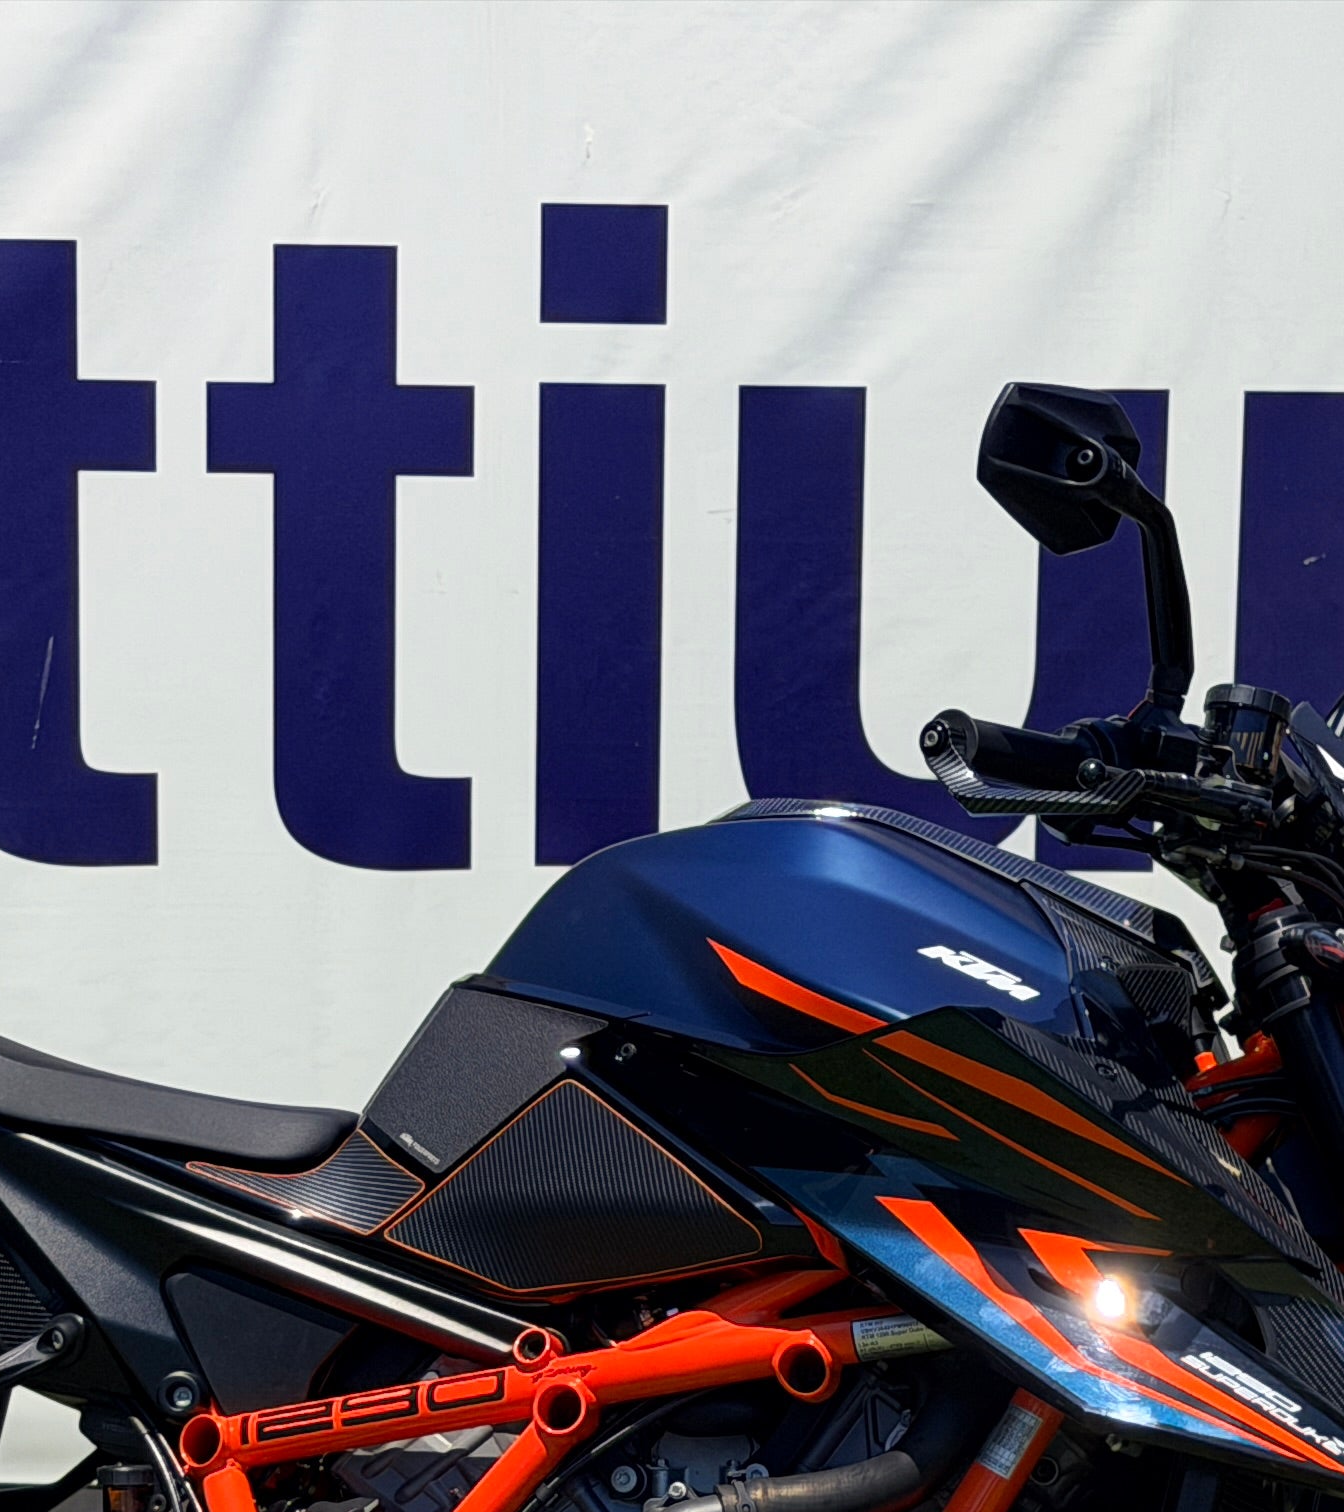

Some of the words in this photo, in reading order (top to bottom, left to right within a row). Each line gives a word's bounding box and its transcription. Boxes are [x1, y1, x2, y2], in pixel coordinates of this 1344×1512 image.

[917, 945, 1041, 1001] KTM
[240, 1369, 505, 1446] 1290
[1199, 1352, 1302, 1413] 1290
